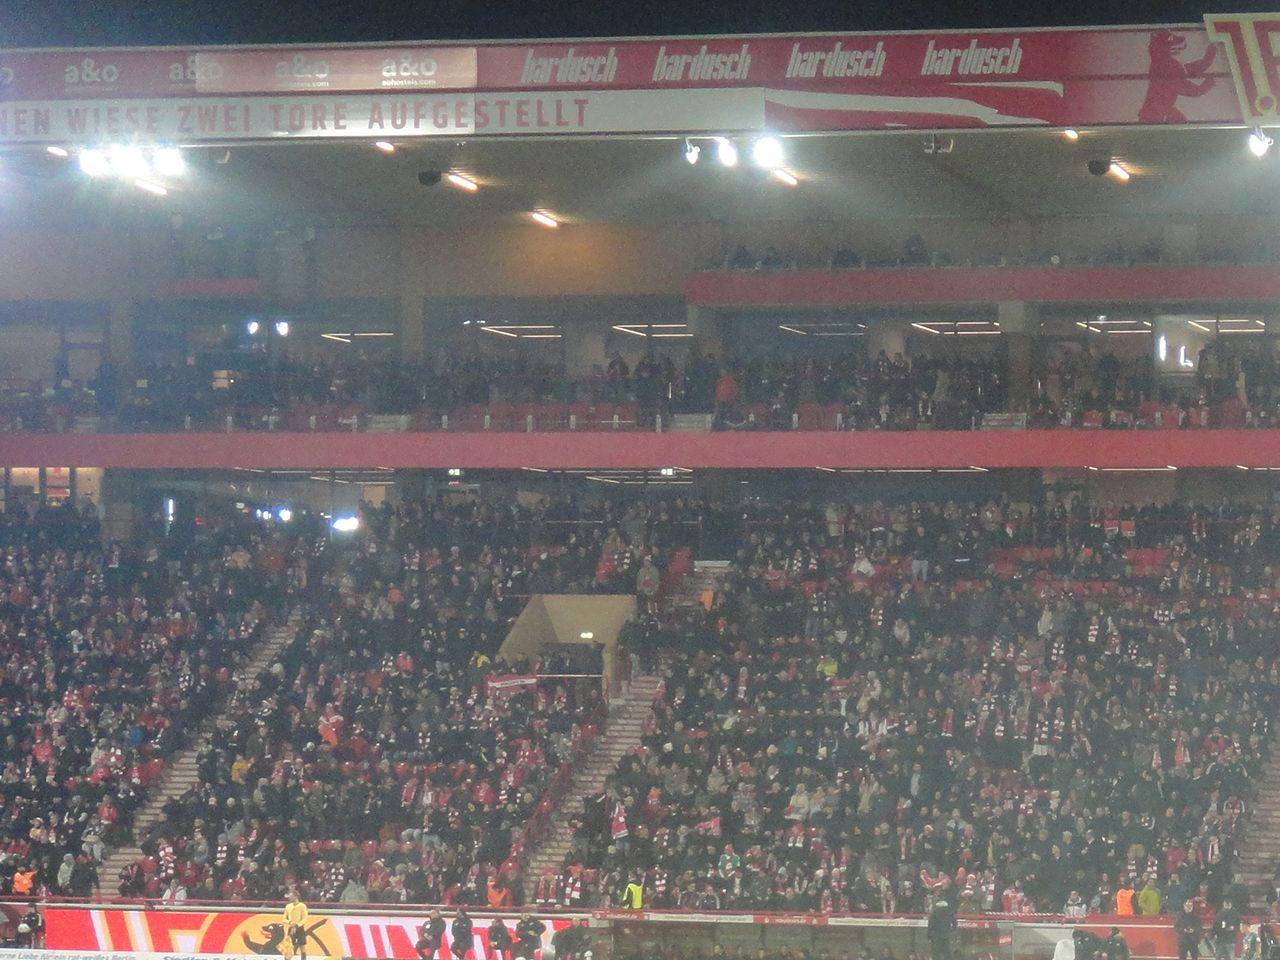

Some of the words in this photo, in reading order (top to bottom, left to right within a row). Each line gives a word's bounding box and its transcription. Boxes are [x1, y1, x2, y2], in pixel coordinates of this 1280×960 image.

[65, 58, 119, 83] a&o
[275, 53, 329, 78] a&o
[382, 52, 437, 76] a&o
[67, 106, 158, 134] WIESE
[177, 104, 250, 134] ZWEI
[269, 102, 347, 131] TORE
[368, 99, 589, 129] AUFGESTELLT
